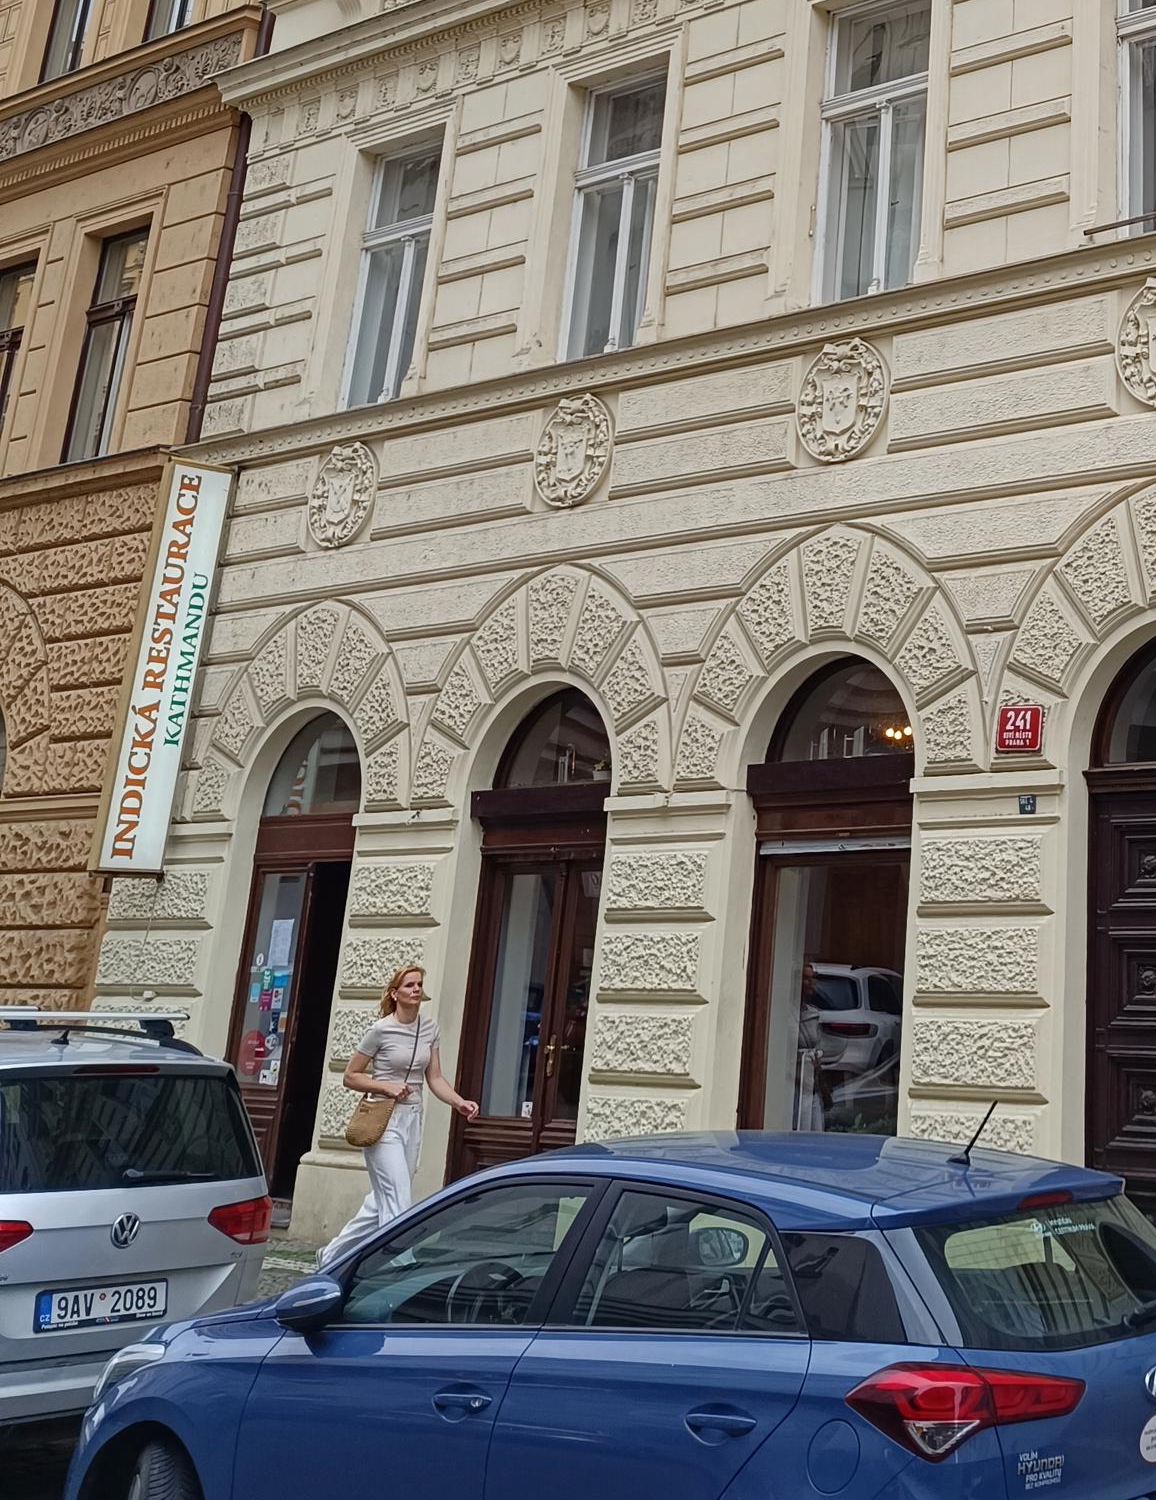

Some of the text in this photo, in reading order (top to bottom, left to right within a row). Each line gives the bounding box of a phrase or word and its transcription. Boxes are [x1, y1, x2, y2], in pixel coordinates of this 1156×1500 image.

[110, 473, 203, 860] INDICKÁ RESTAURACE
[163, 572, 209, 747] KATHMANDU
[1005, 710, 1032, 730] 241
[57, 1286, 158, 1320] 9AV 2089
[40, 1314, 50, 1323] CZ
[1017, 1454, 1064, 1476] HYUNDAI
